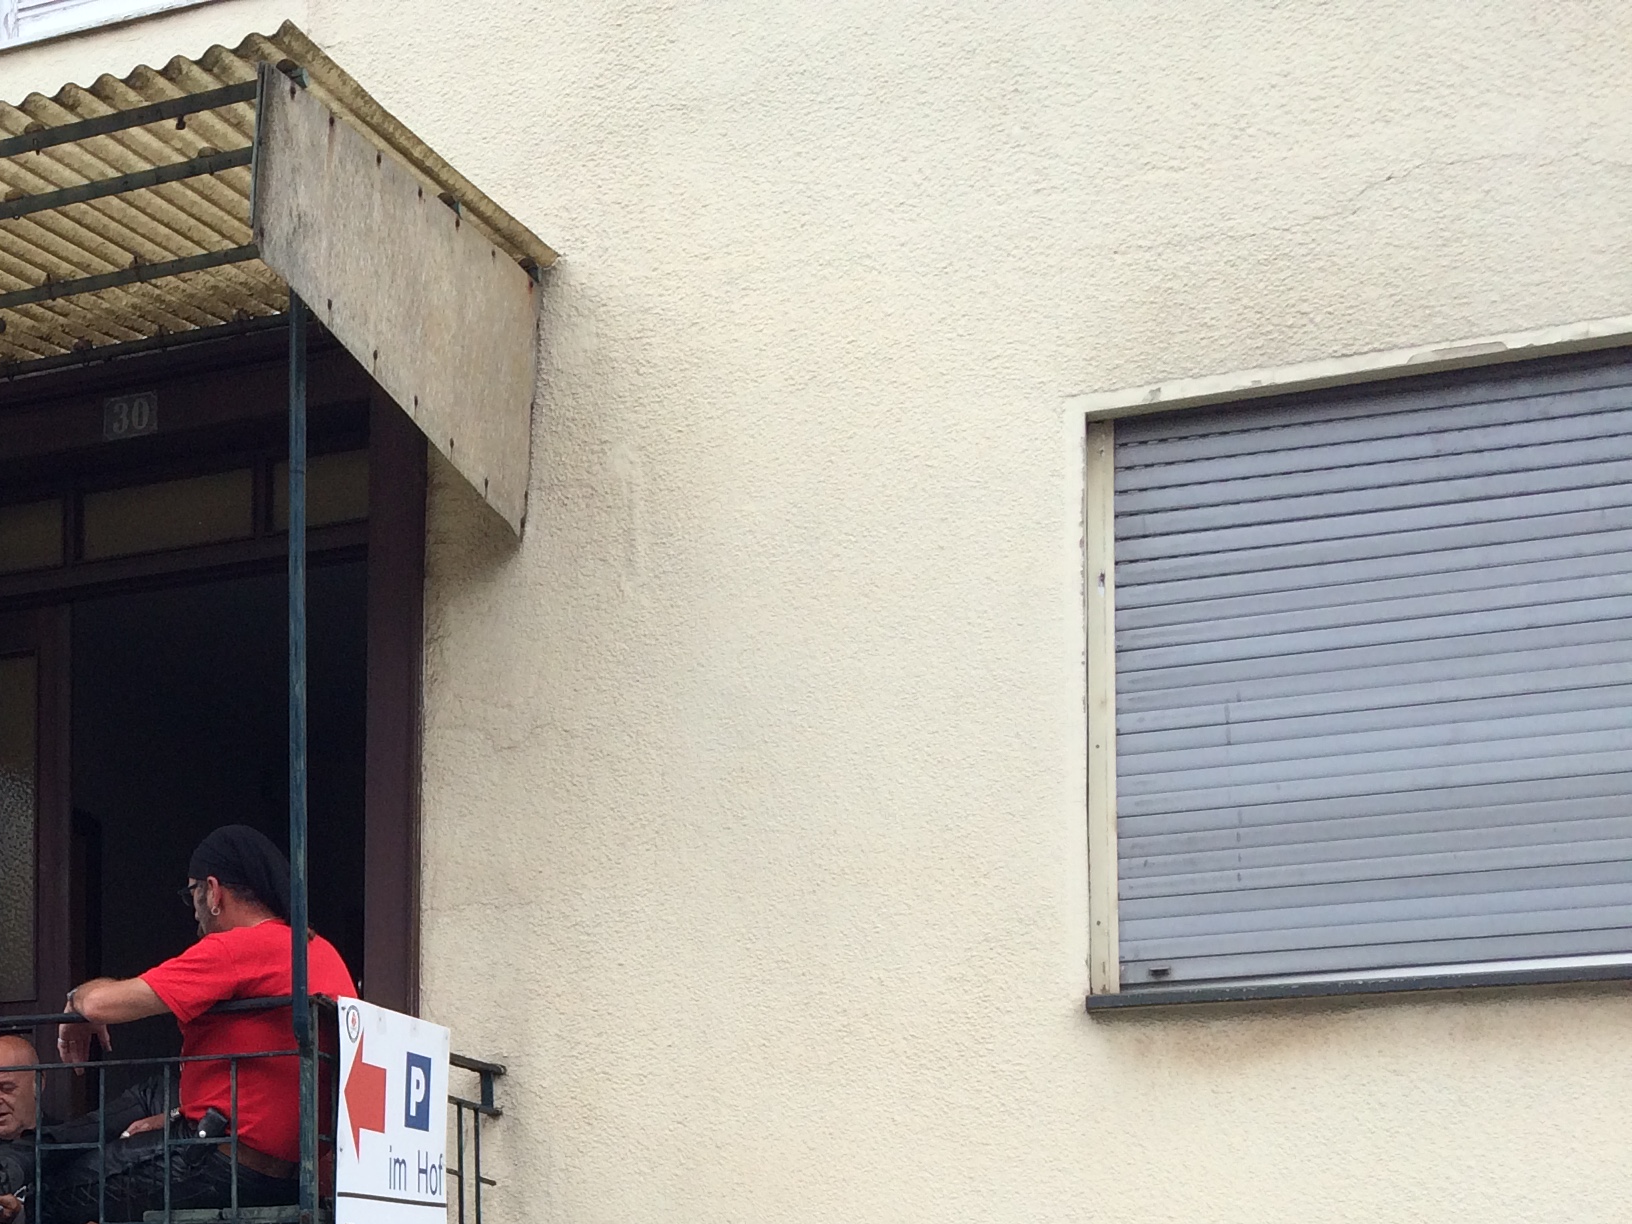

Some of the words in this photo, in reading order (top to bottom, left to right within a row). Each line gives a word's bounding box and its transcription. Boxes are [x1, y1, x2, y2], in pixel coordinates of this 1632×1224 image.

[113, 397, 150, 433] 30
[409, 1066, 426, 1117] P
[388, 1145, 408, 1192] im
[417, 1149, 443, 1196] Hof
